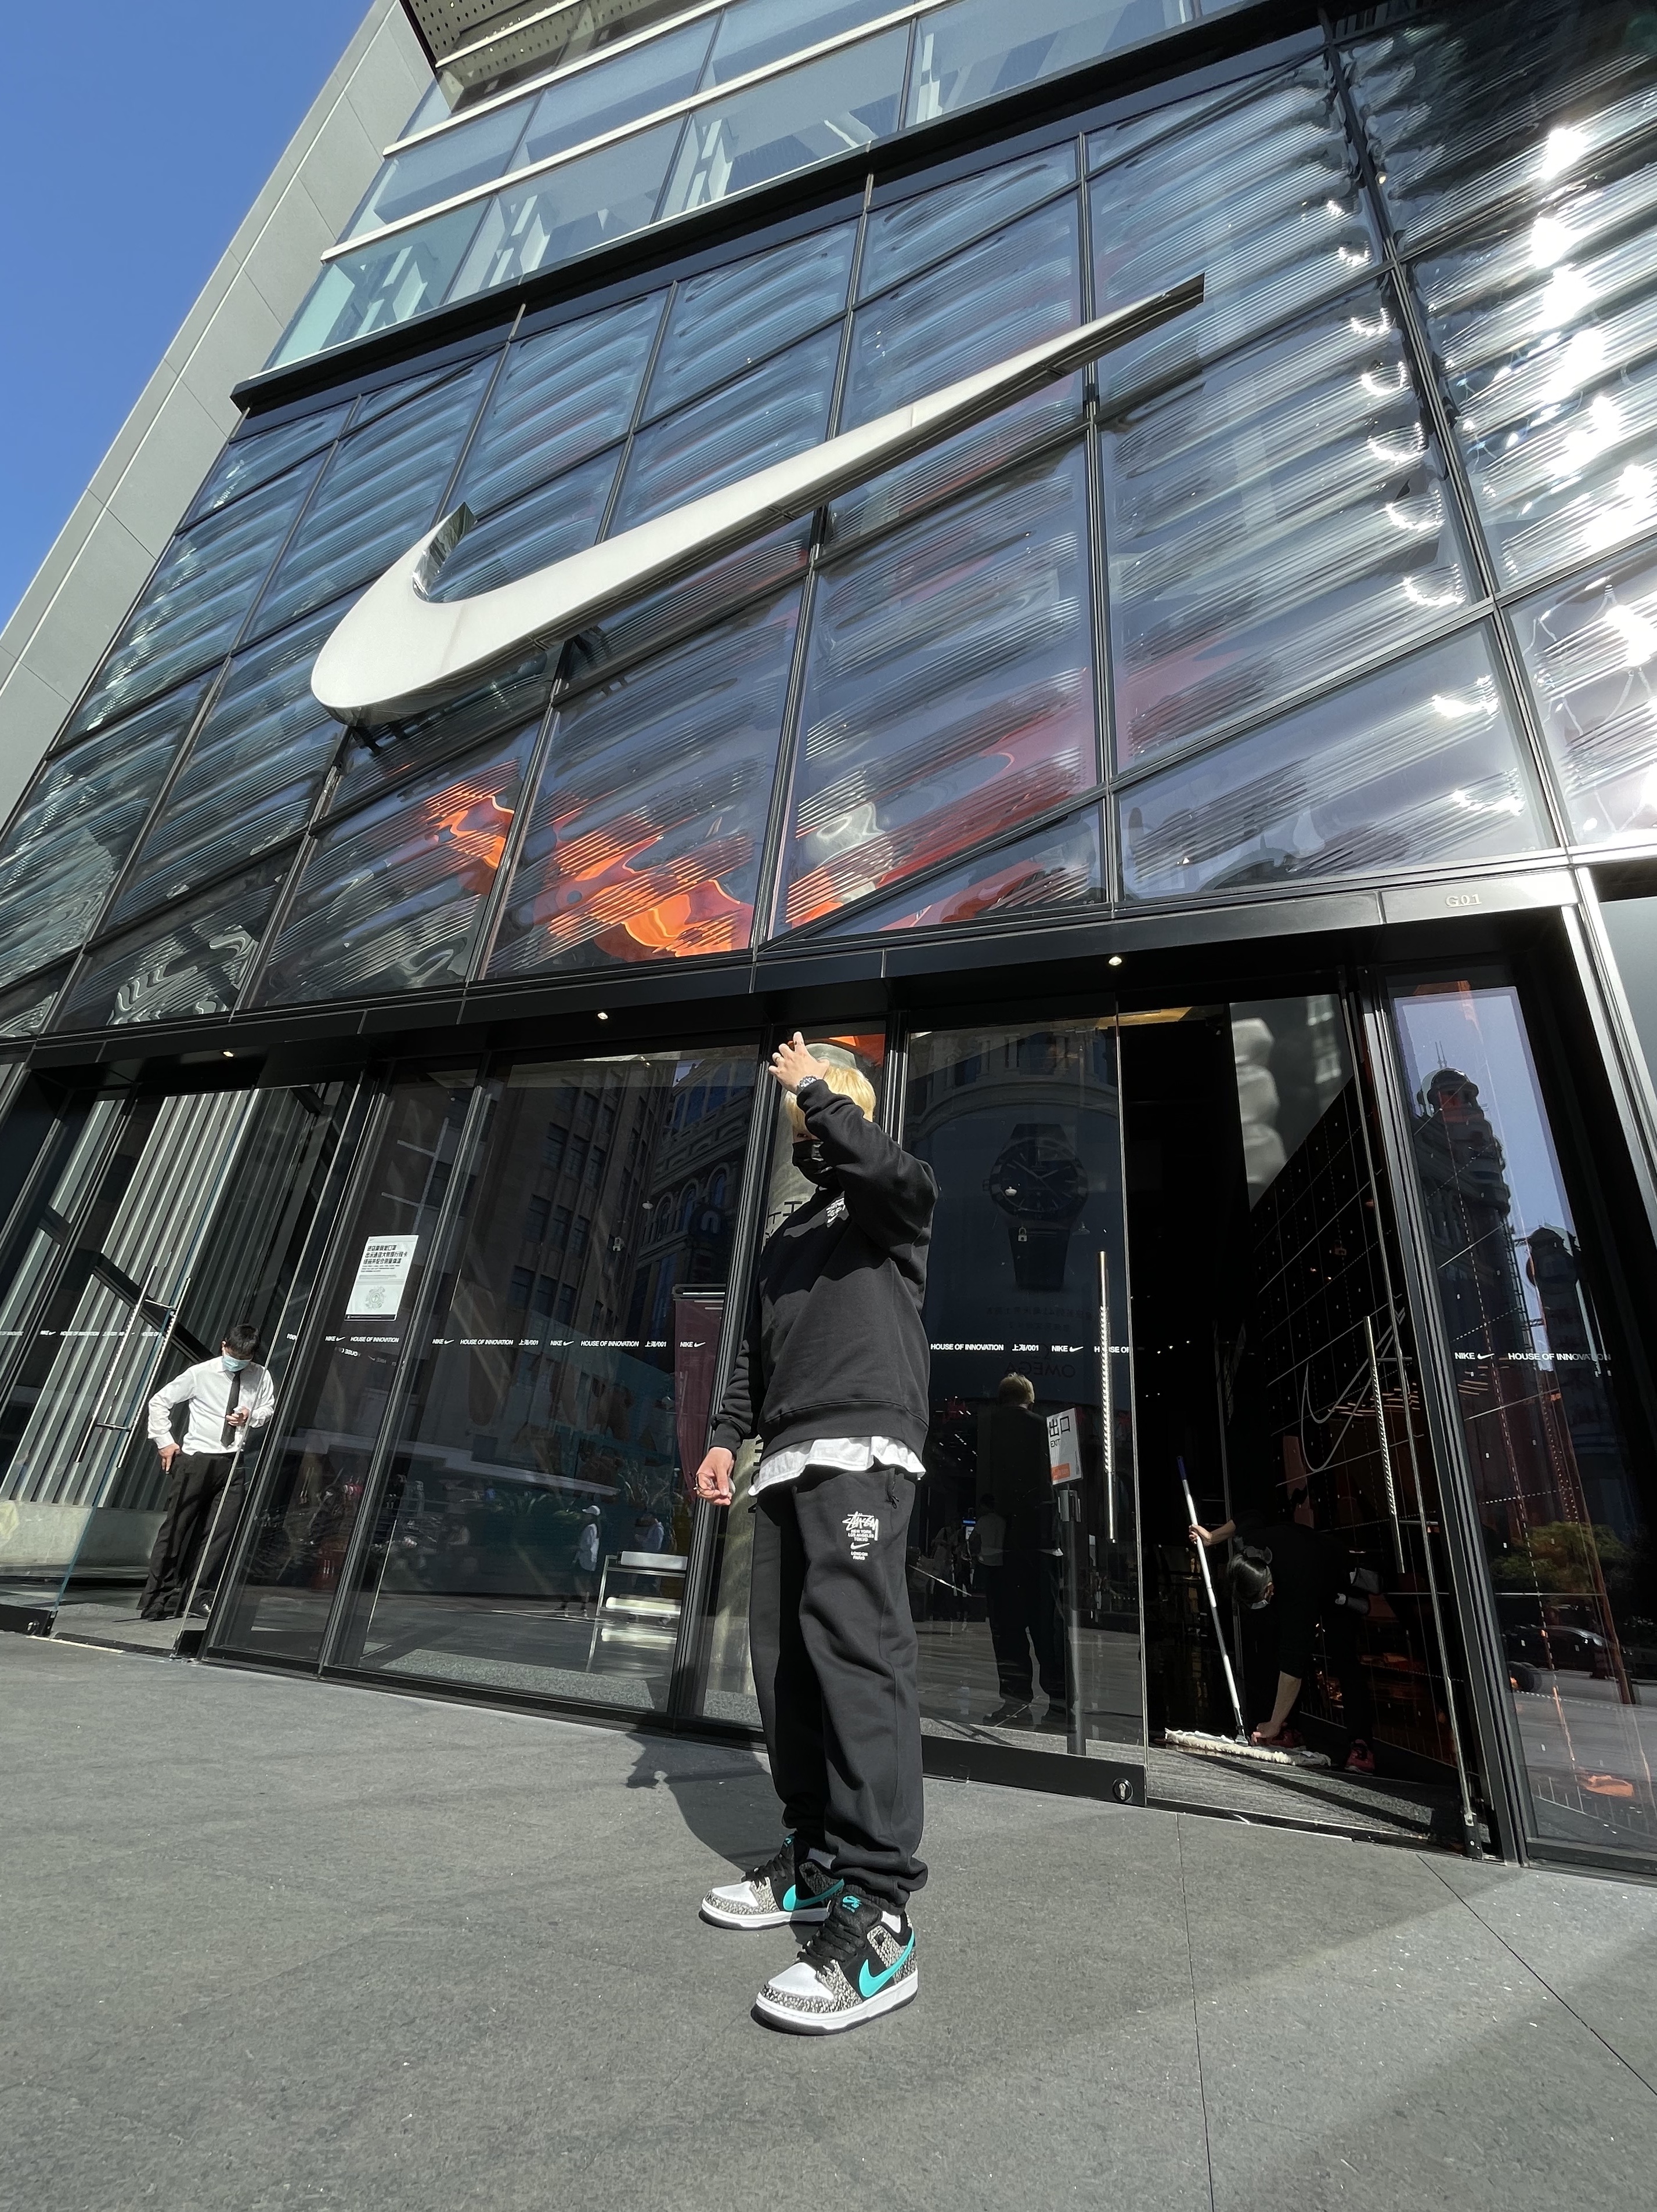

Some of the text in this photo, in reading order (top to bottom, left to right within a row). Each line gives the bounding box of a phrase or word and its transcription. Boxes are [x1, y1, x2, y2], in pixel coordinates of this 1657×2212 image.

[1445, 893, 1482, 909] G01
[1049, 1416, 1070, 1437] 出口
[1050, 1438, 1061, 1448] EXIT
